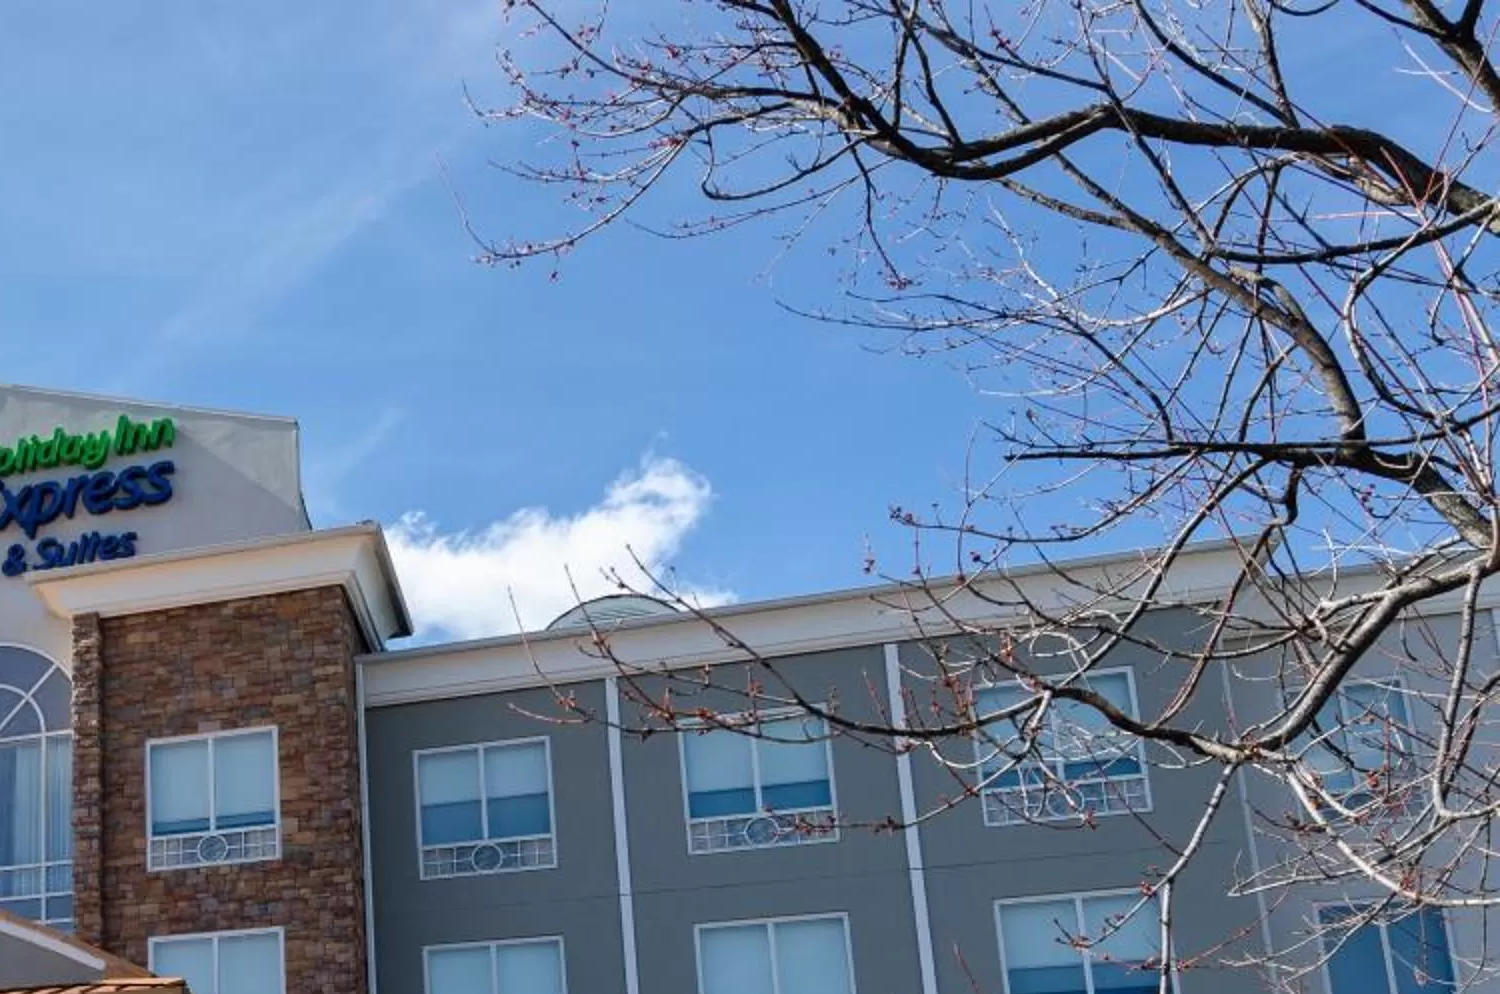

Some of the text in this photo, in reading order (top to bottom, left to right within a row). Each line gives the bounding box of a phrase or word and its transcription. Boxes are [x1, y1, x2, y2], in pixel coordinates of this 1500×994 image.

[114, 414, 175, 456] Inn
[2, 531, 138, 577] & Suites
